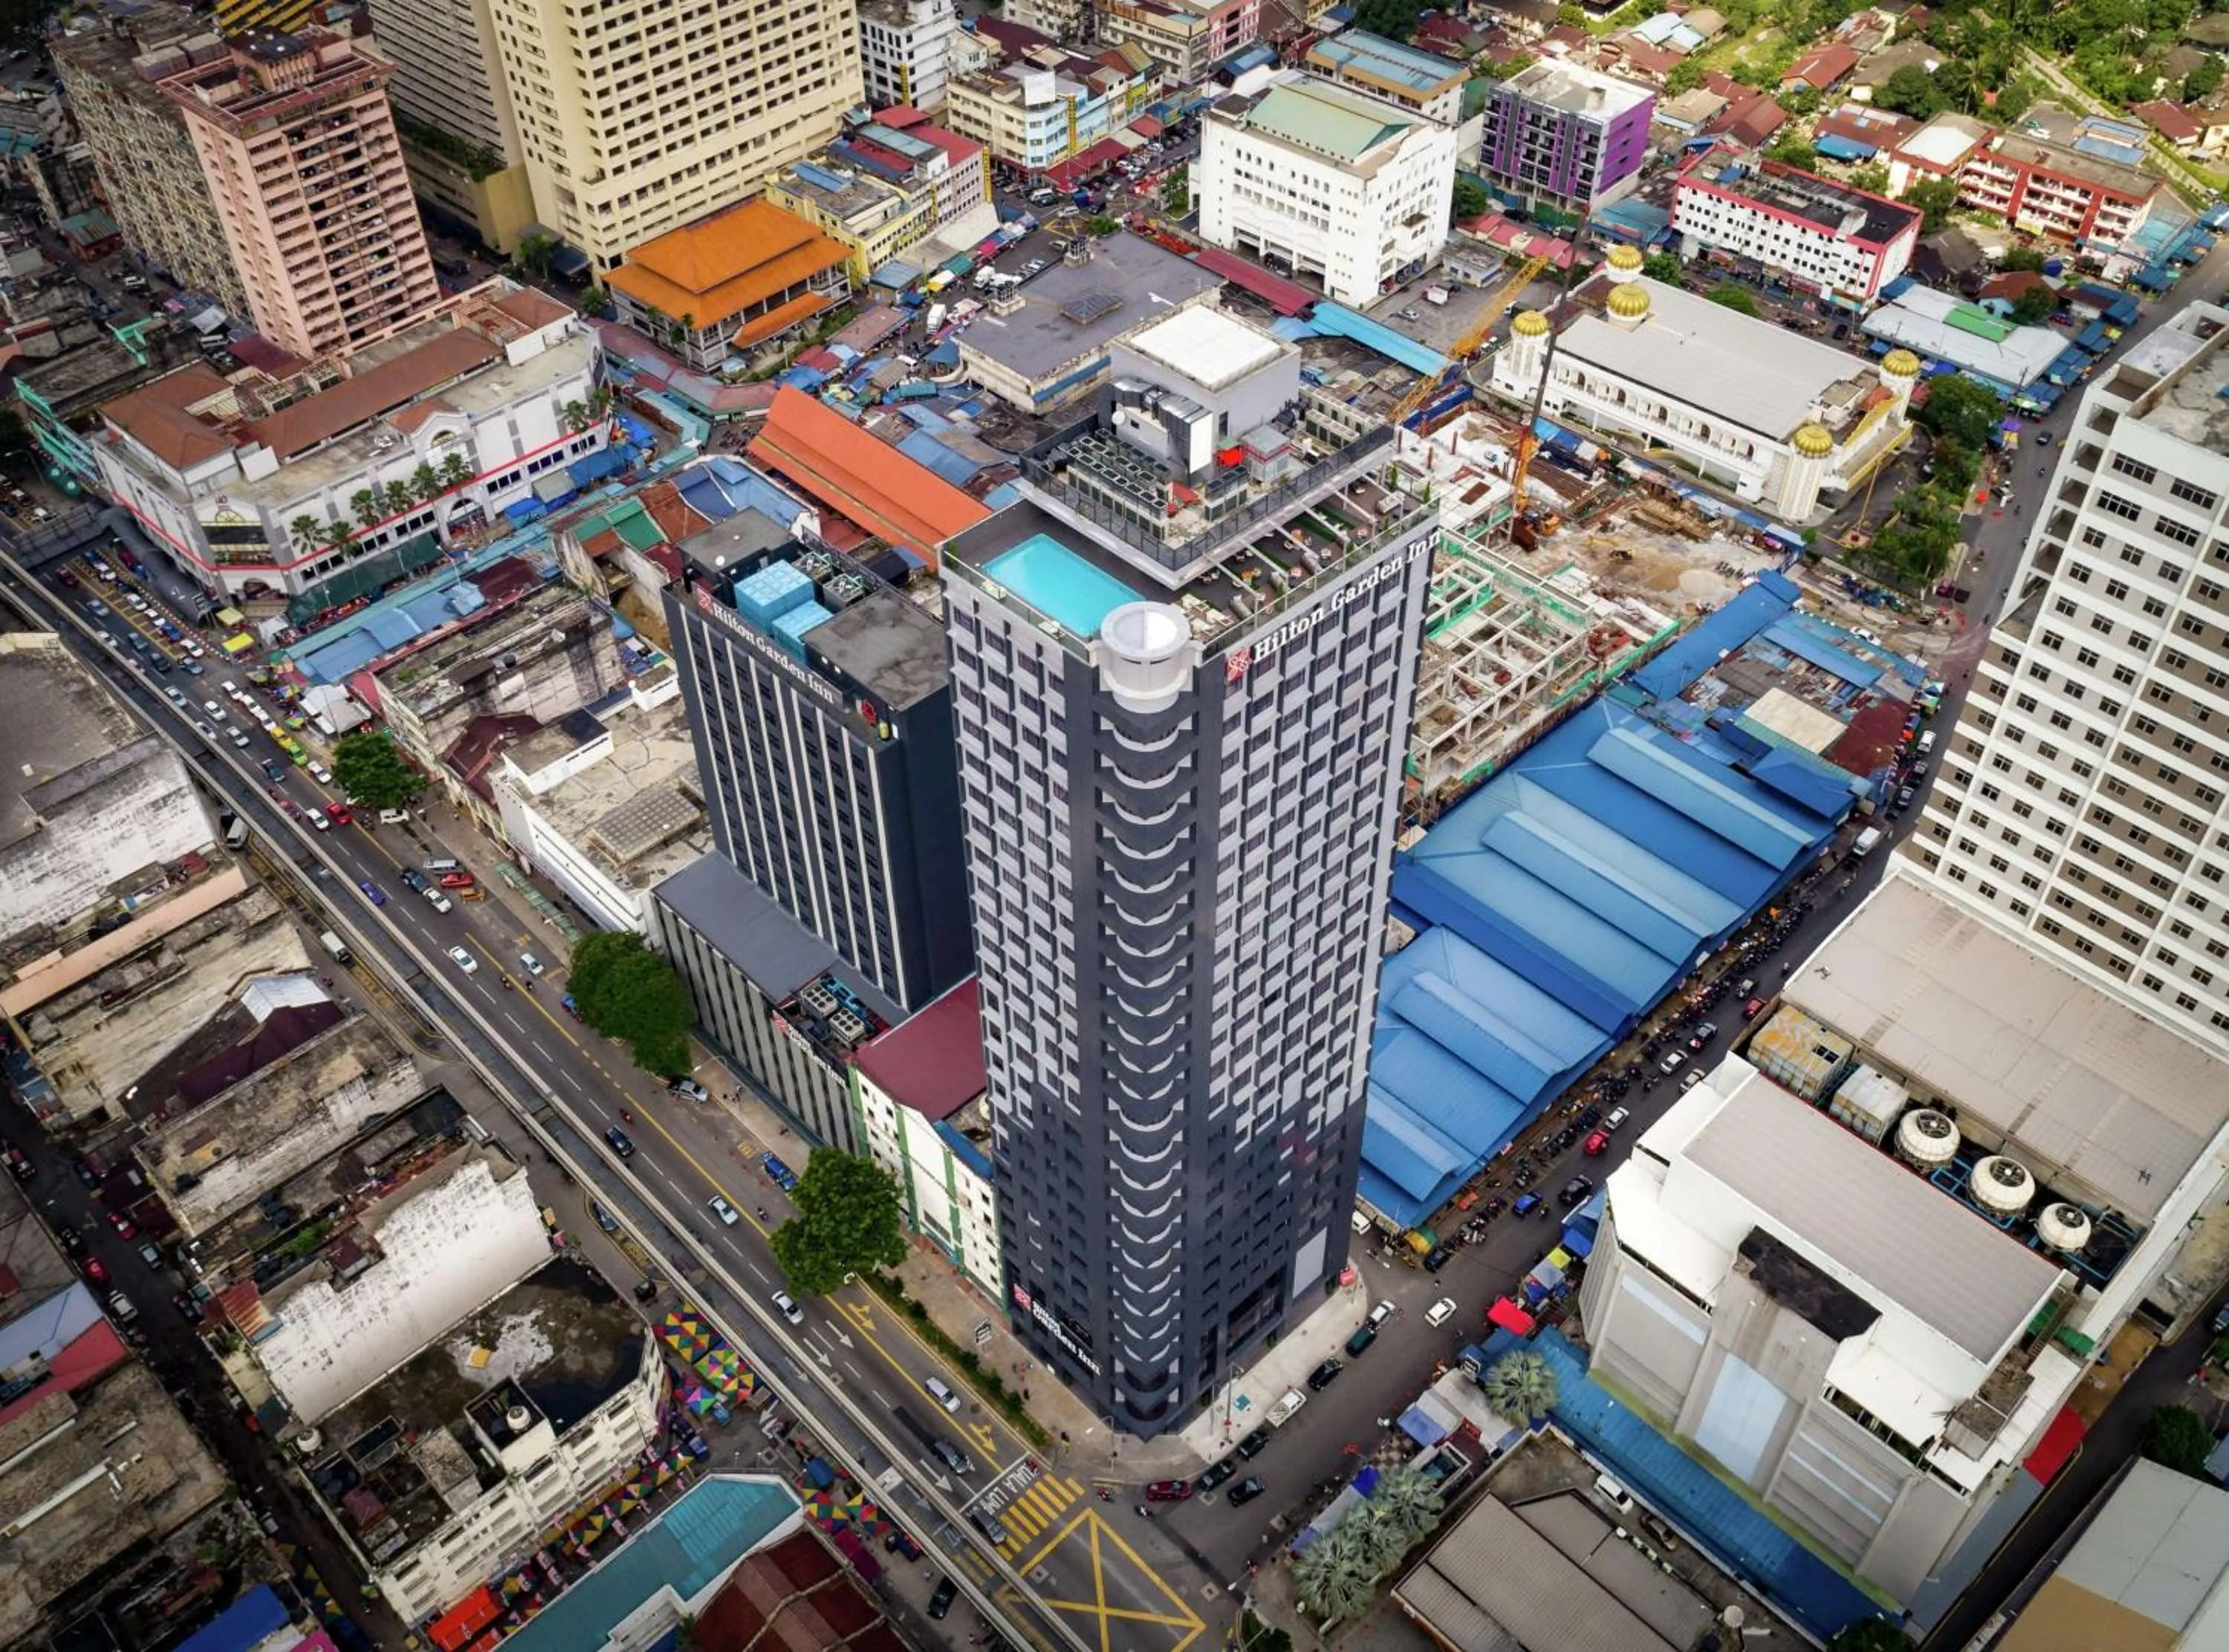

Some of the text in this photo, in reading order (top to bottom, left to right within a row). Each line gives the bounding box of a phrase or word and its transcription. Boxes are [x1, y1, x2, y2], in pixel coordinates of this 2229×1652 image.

[1253, 529, 1441, 662] Hilton Garden Inn
[712, 602, 834, 703] Hilton Garden Inn
[1002, 1461, 1040, 1494] UALA
